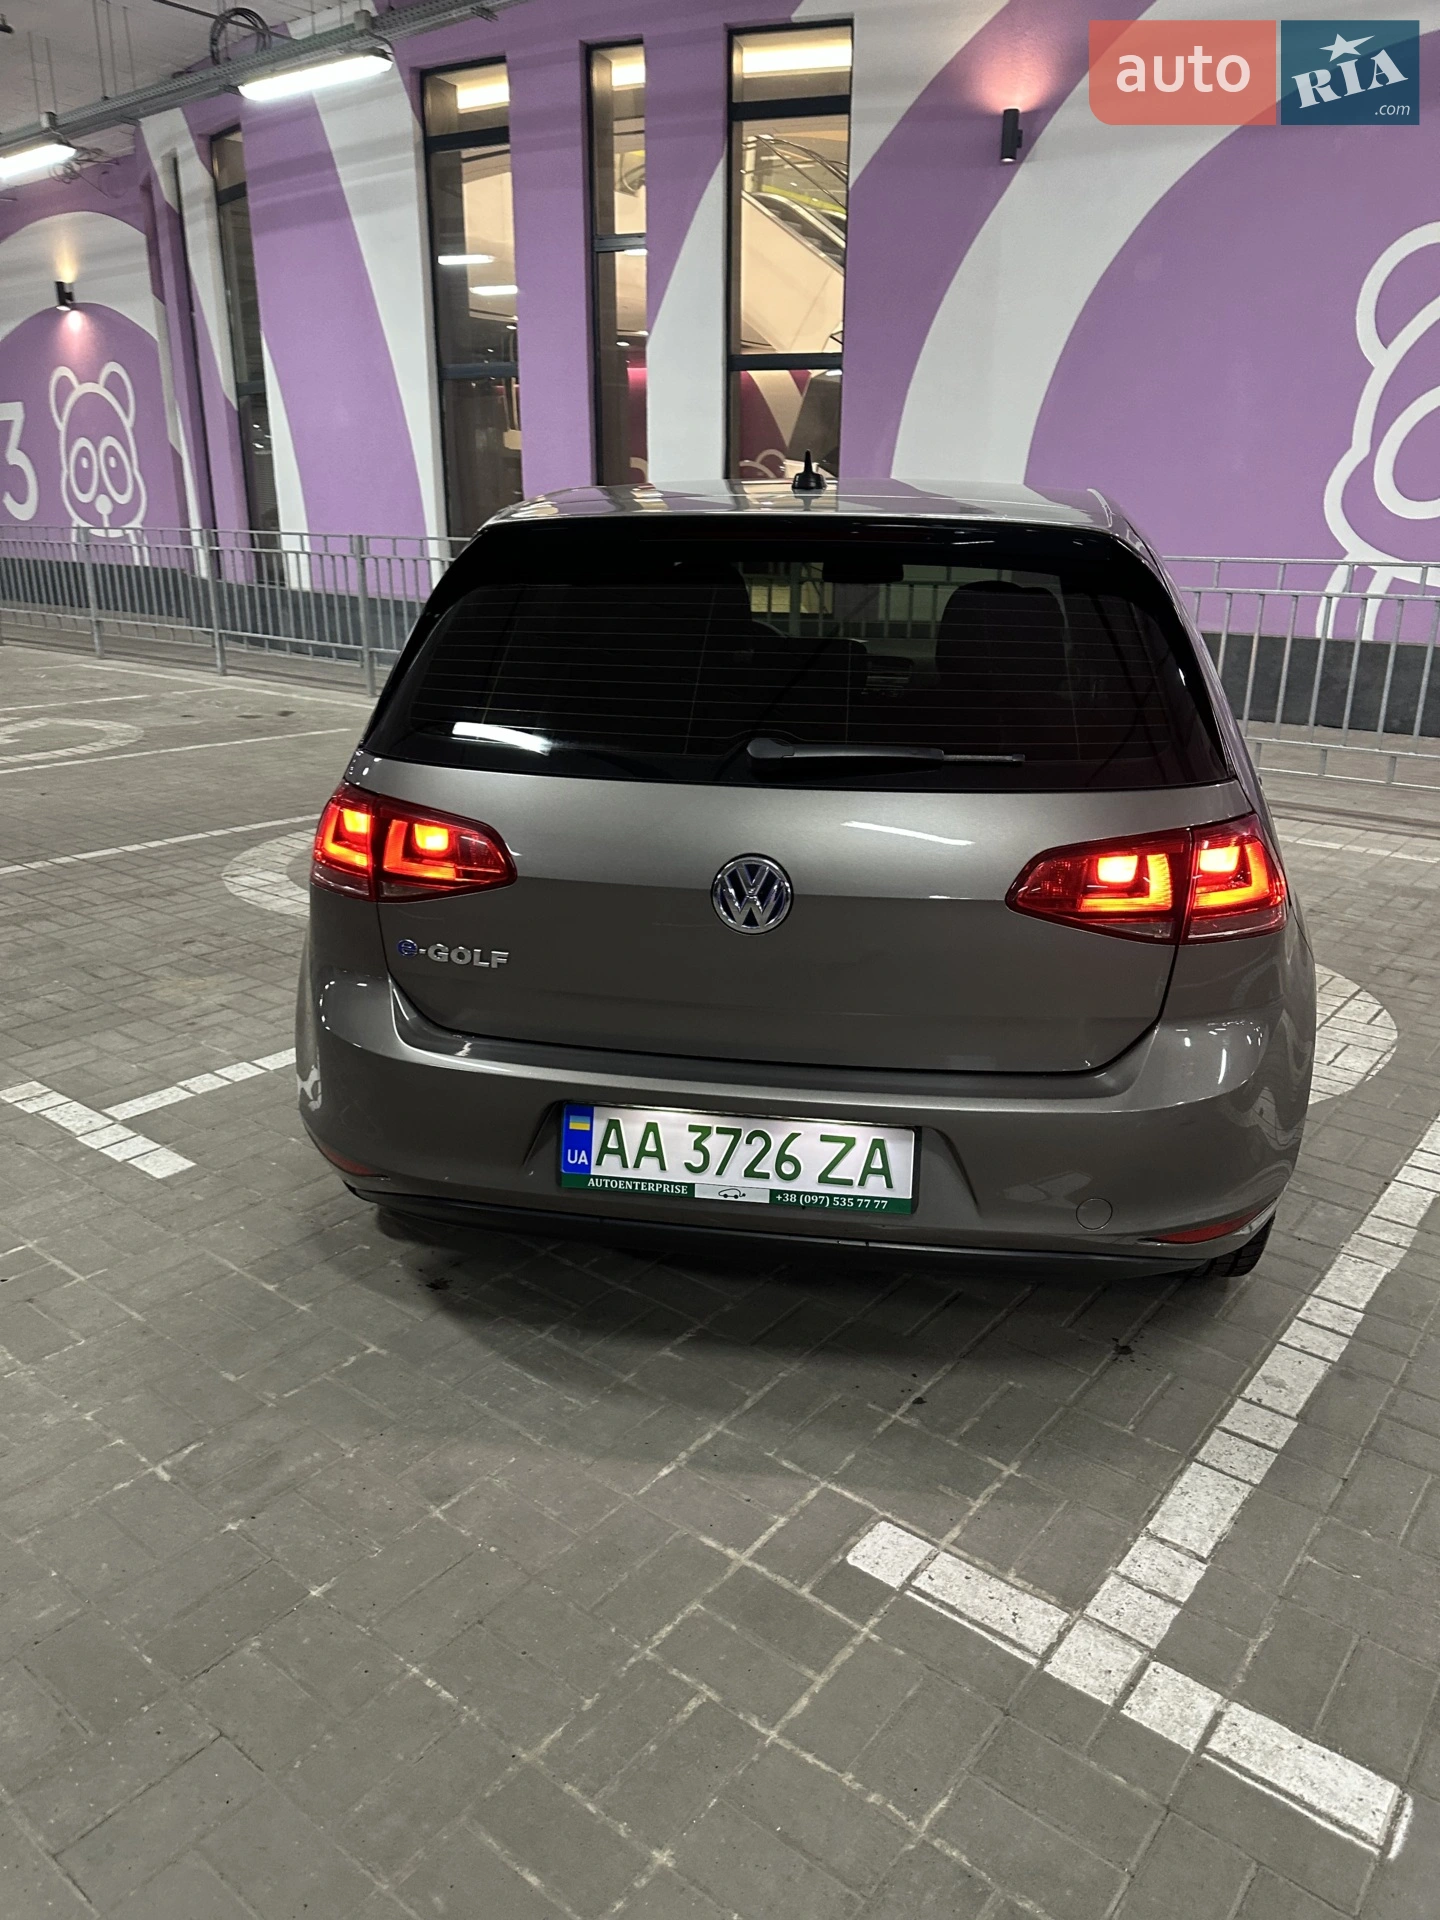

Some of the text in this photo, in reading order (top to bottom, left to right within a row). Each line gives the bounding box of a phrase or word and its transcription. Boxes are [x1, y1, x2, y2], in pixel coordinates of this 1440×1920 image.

[397, 939, 510, 969] e-GOLF
[567, 1149, 589, 1166] UA
[595, 1118, 894, 1189] AA 3726 ZA
[587, 1177, 688, 1195] AUTOENTERPRISE
[775, 1193, 888, 1210] +38 (097) 535 77 77
